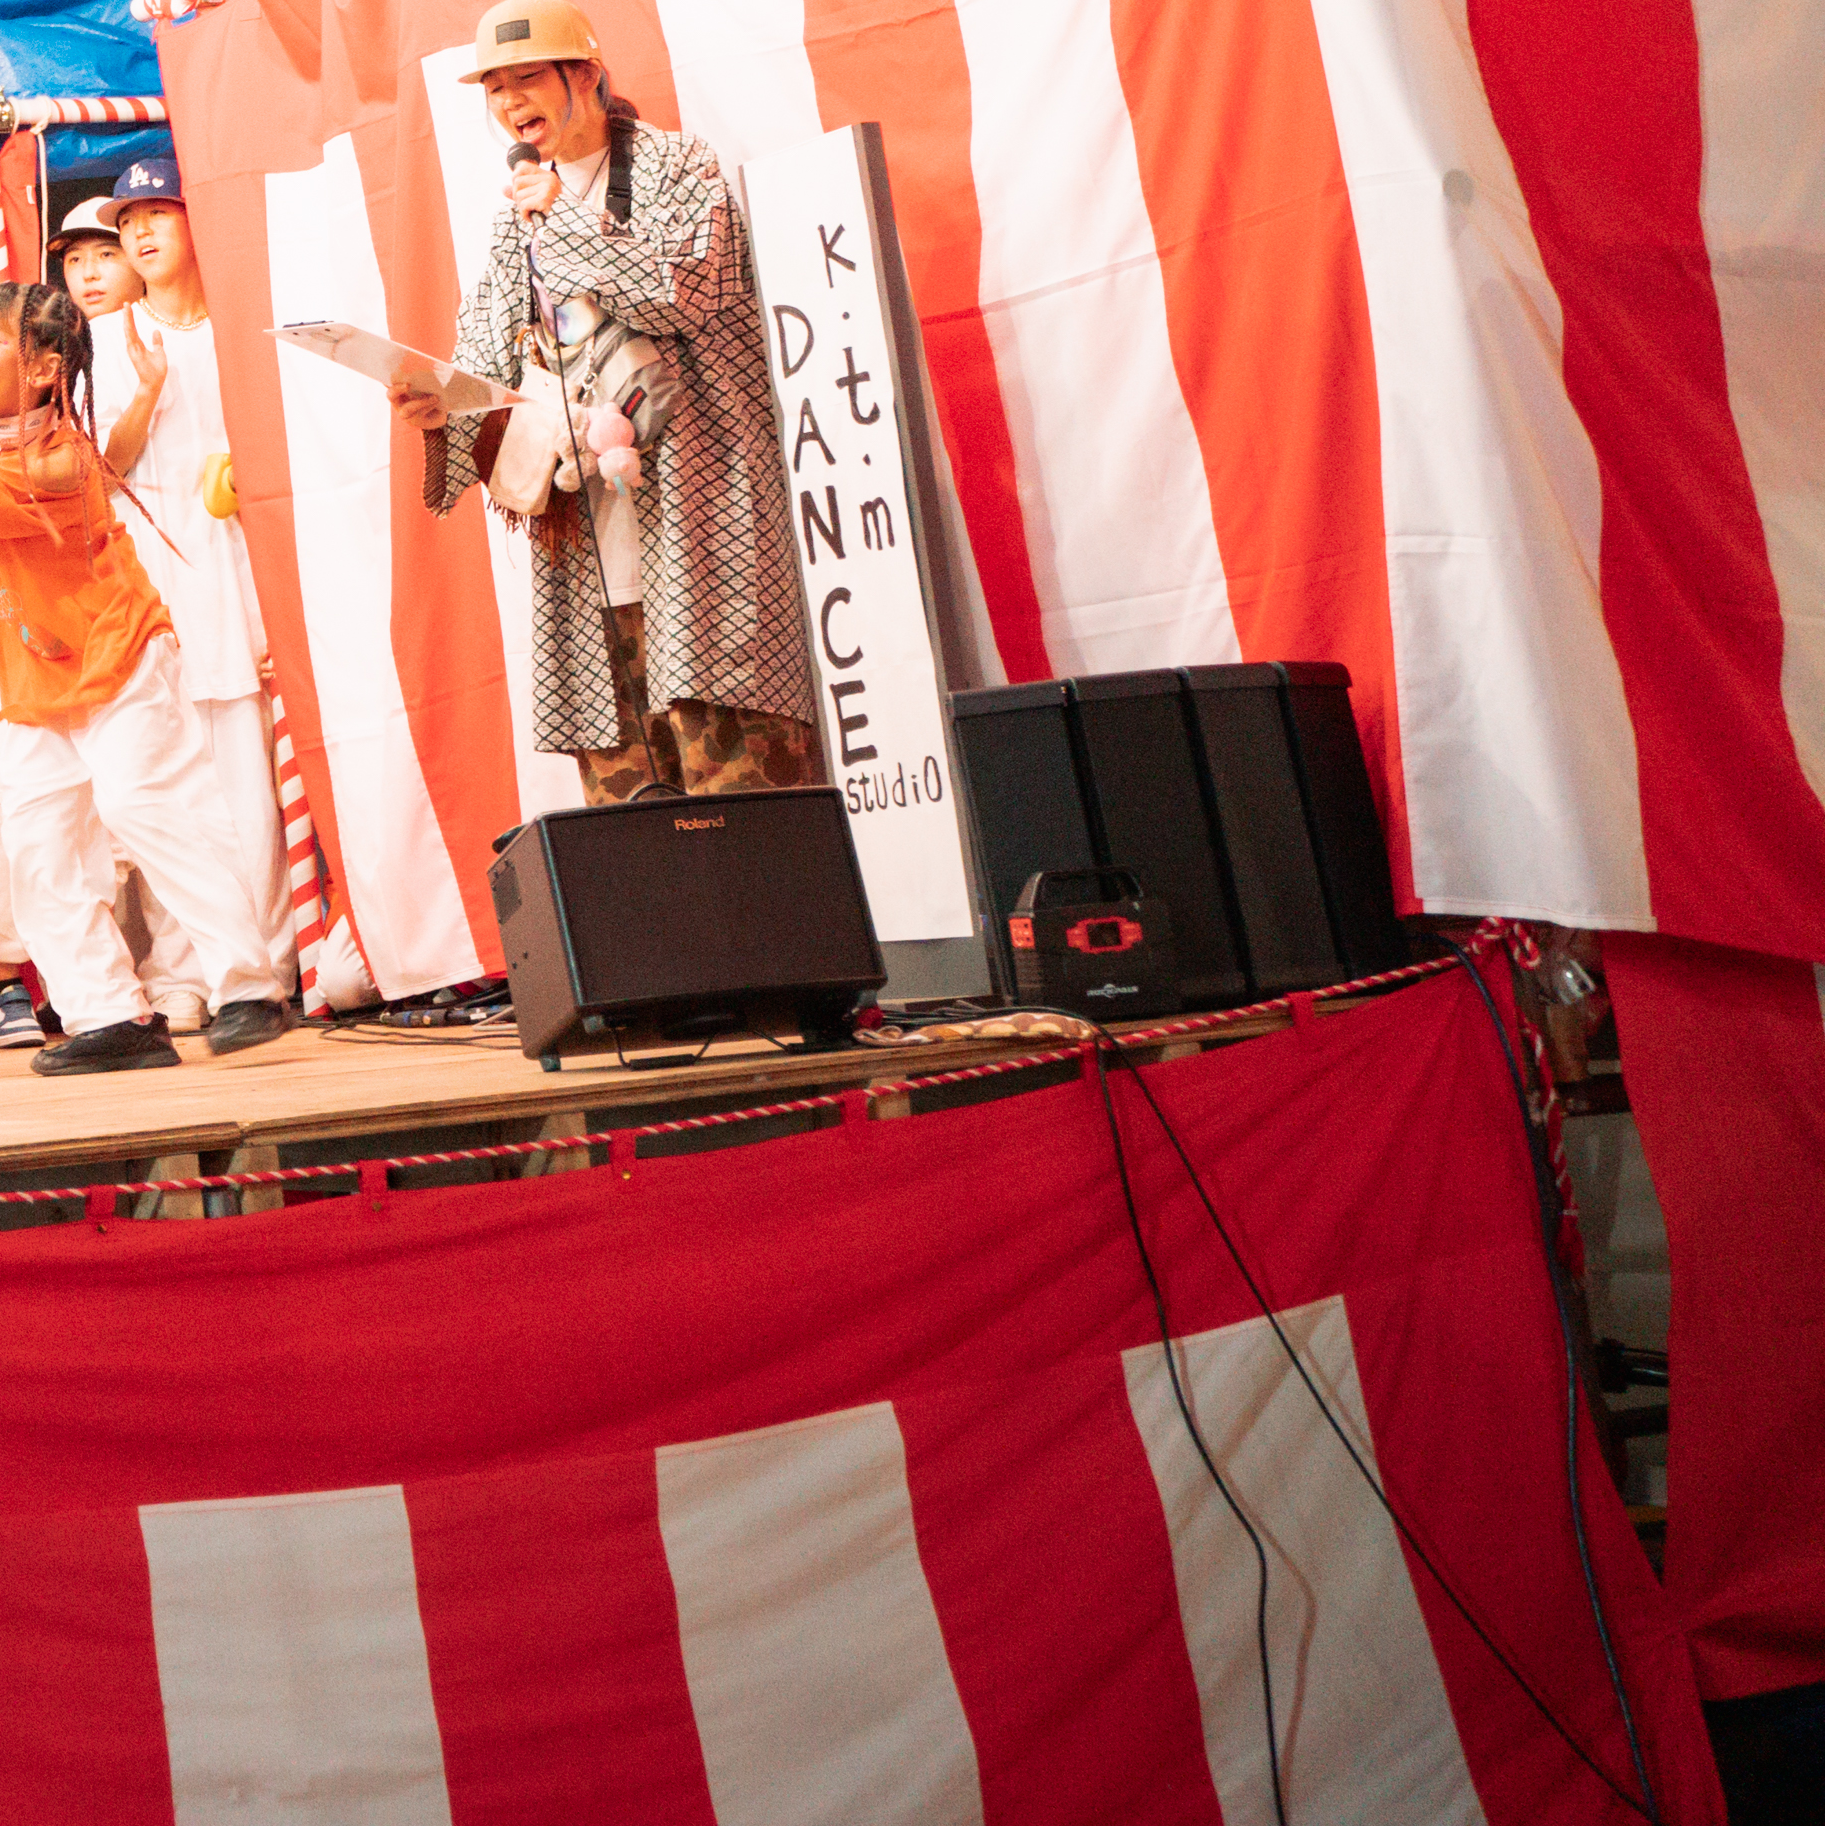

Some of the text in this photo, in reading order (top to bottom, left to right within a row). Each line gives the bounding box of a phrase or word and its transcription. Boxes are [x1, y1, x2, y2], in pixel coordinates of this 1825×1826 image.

[128, 163, 150, 189] LA
[772, 304, 878, 767] DANCE
[674, 815, 726, 831] Roland
